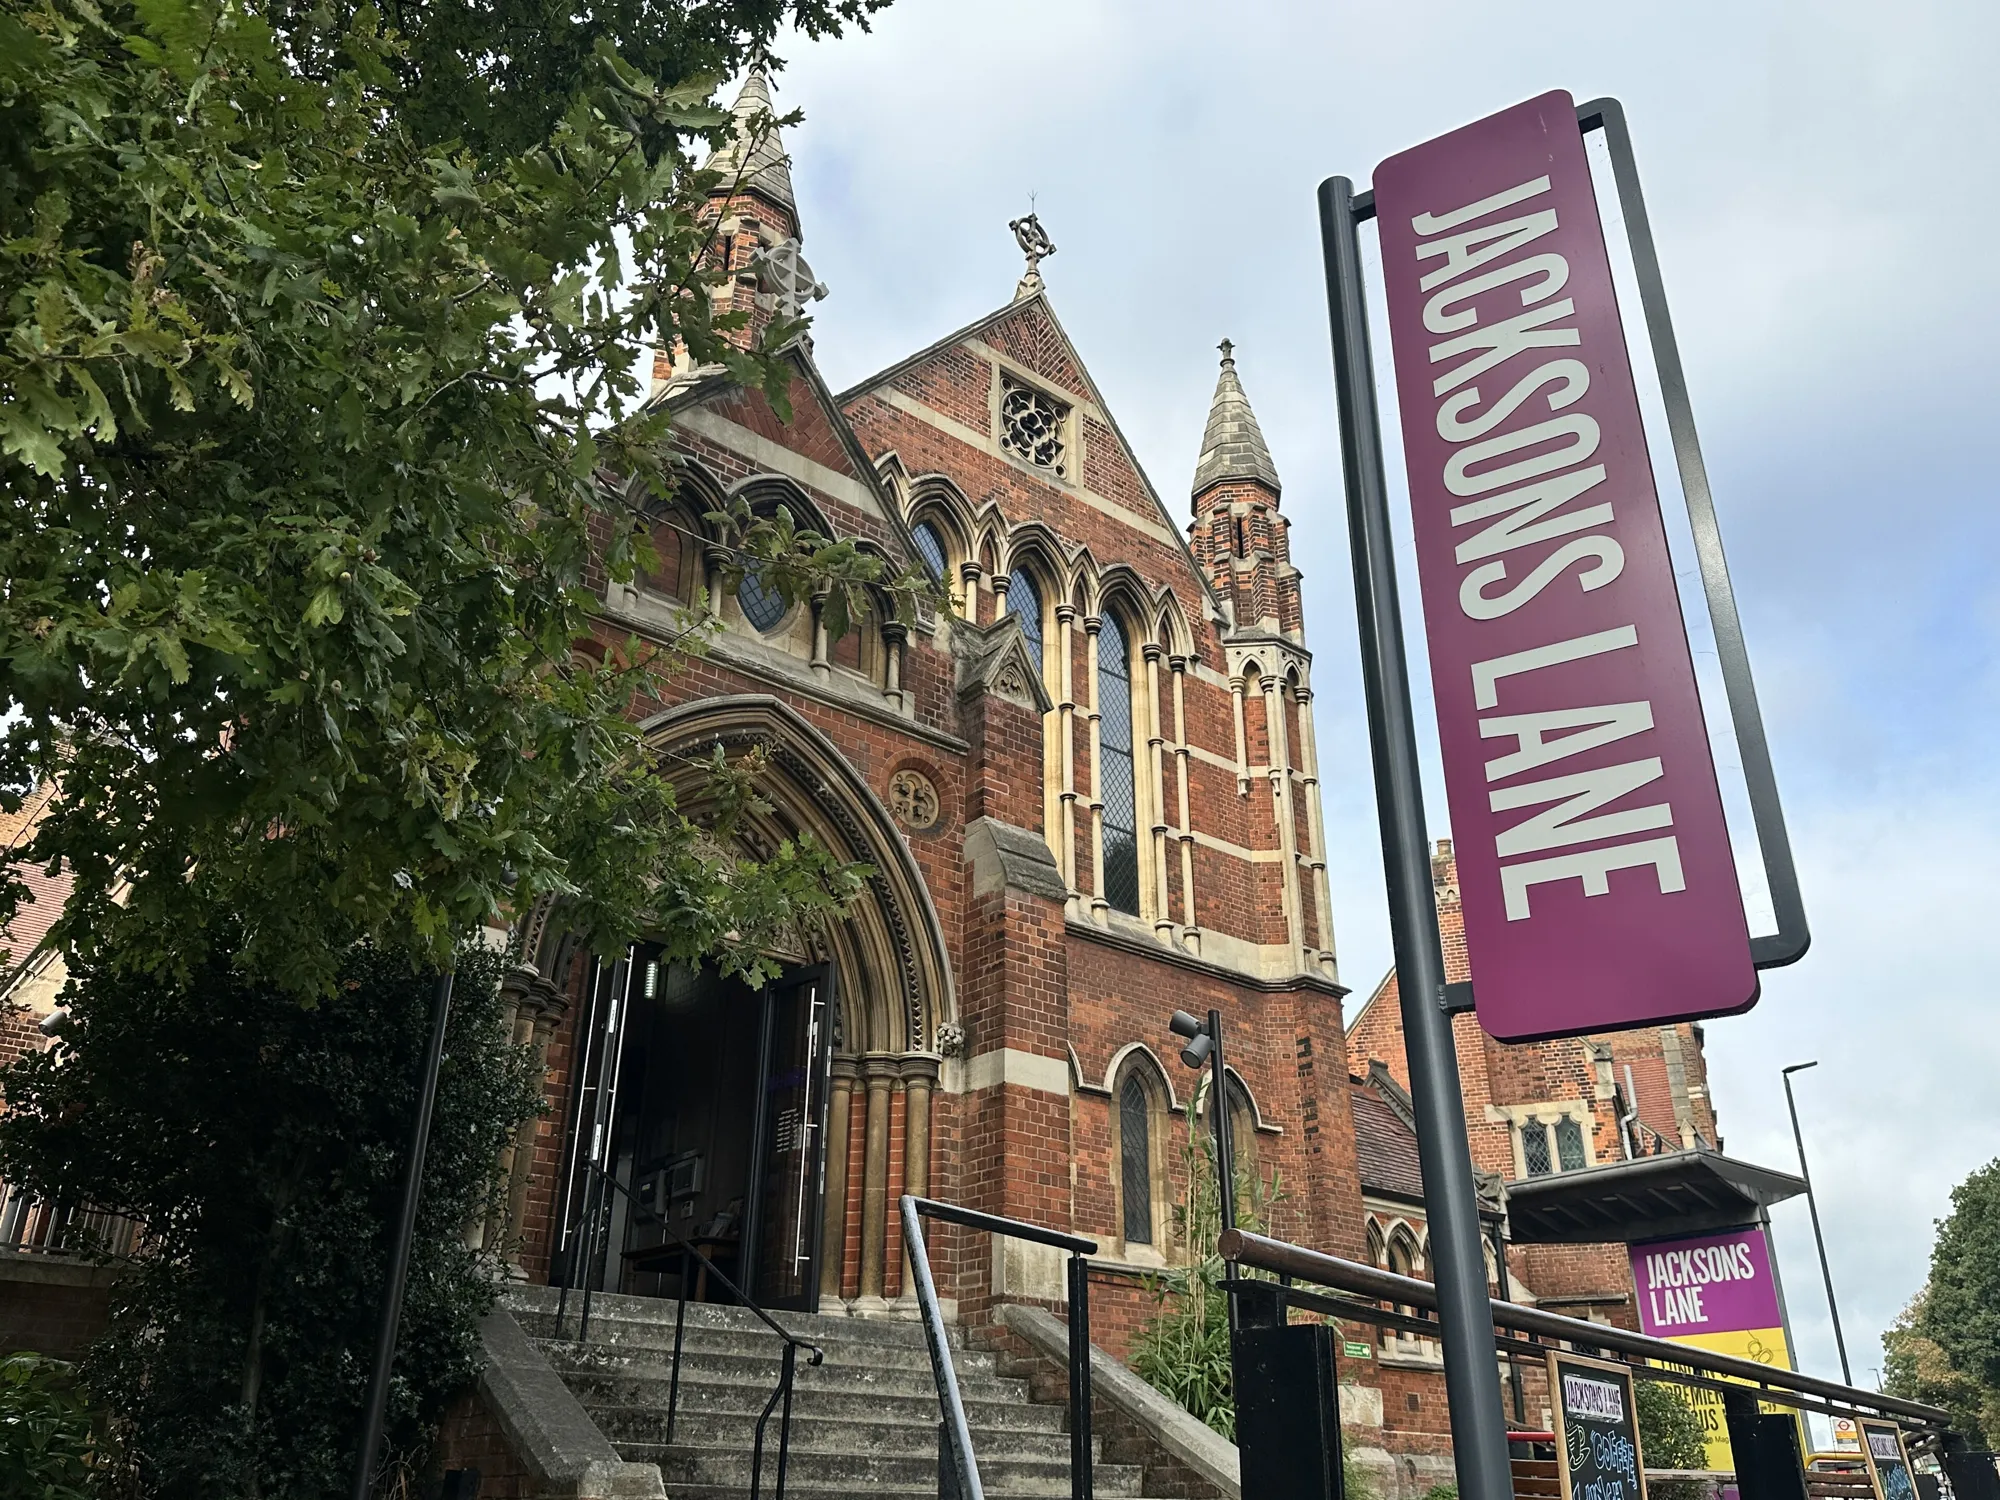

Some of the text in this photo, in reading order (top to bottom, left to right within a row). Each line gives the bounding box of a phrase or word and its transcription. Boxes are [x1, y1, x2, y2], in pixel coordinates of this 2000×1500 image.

[1411, 174, 1686, 922] JACKSONS LANE
[1646, 1242, 1755, 1290] JACKSONS
[1649, 1286, 1709, 1326] LANE
[1566, 1380, 1622, 1416] JACKSONS LANE
